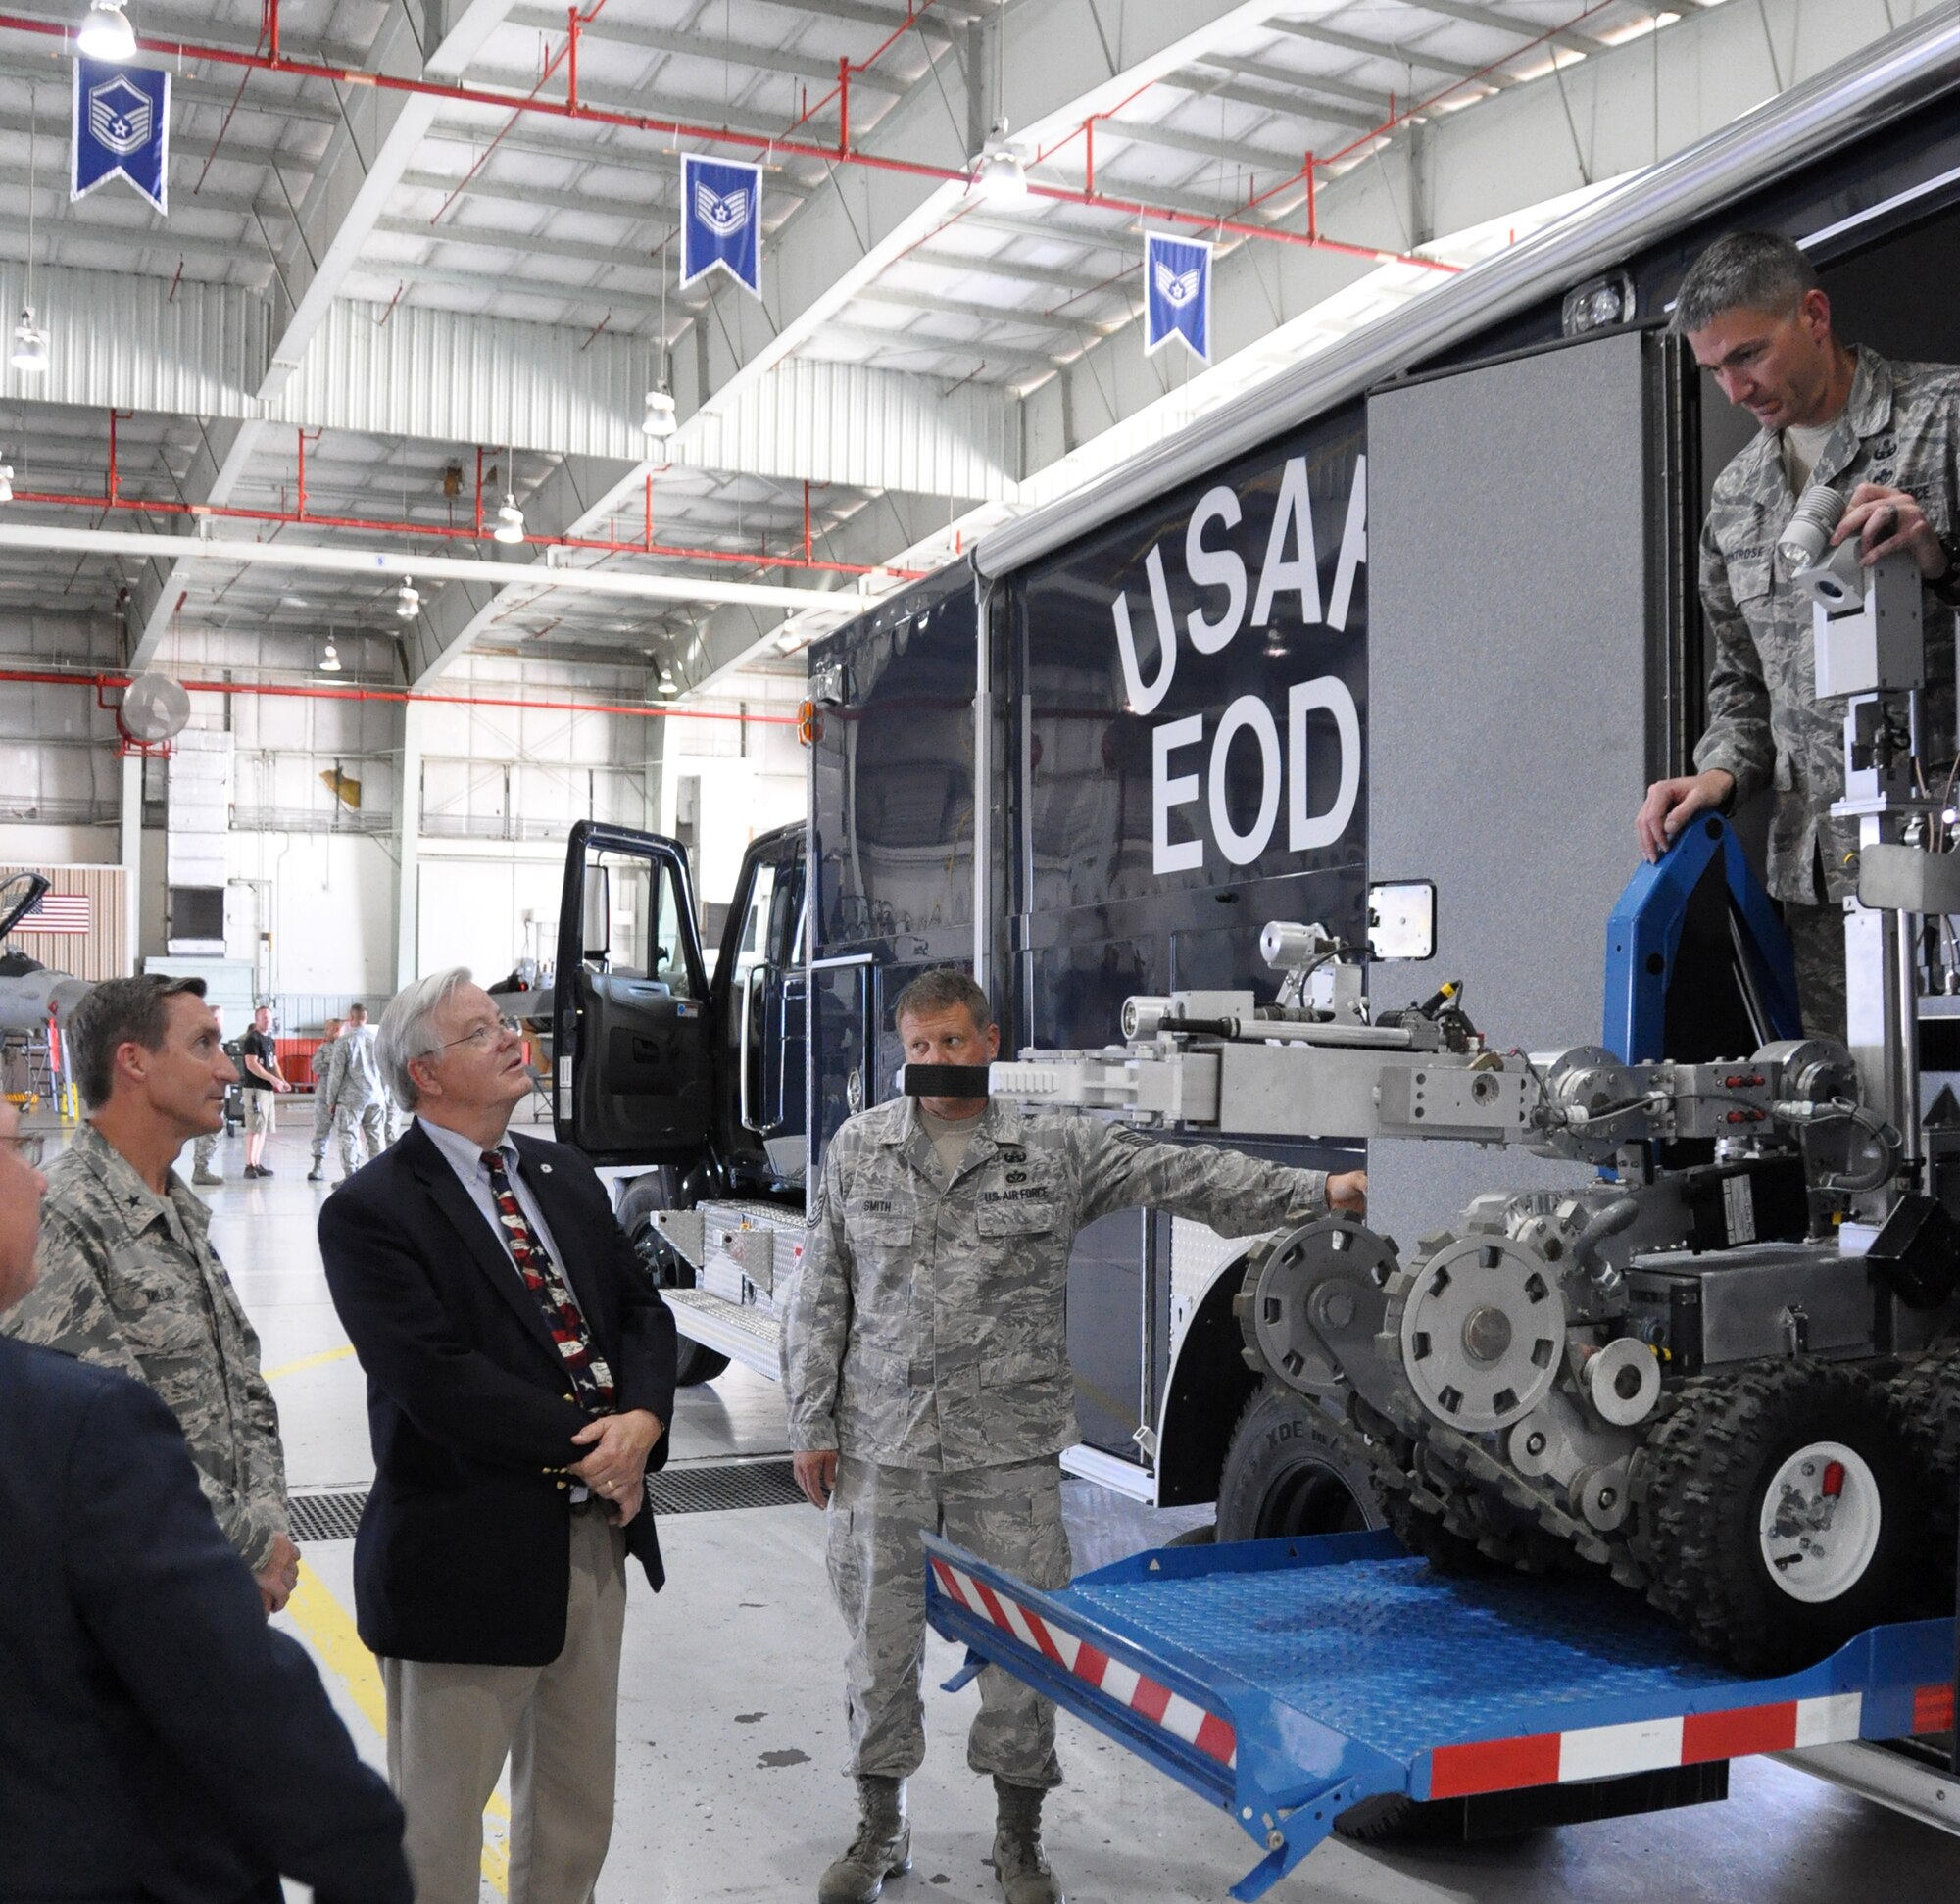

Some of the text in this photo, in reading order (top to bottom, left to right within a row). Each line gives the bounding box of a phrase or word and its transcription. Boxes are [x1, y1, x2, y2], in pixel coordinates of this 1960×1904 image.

[1152, 675, 1361, 875] EOD
[1002, 1190, 1019, 1201] AIR
[1020, 1186, 1048, 1199] FORCE
[863, 1199, 892, 1212] SMITH
